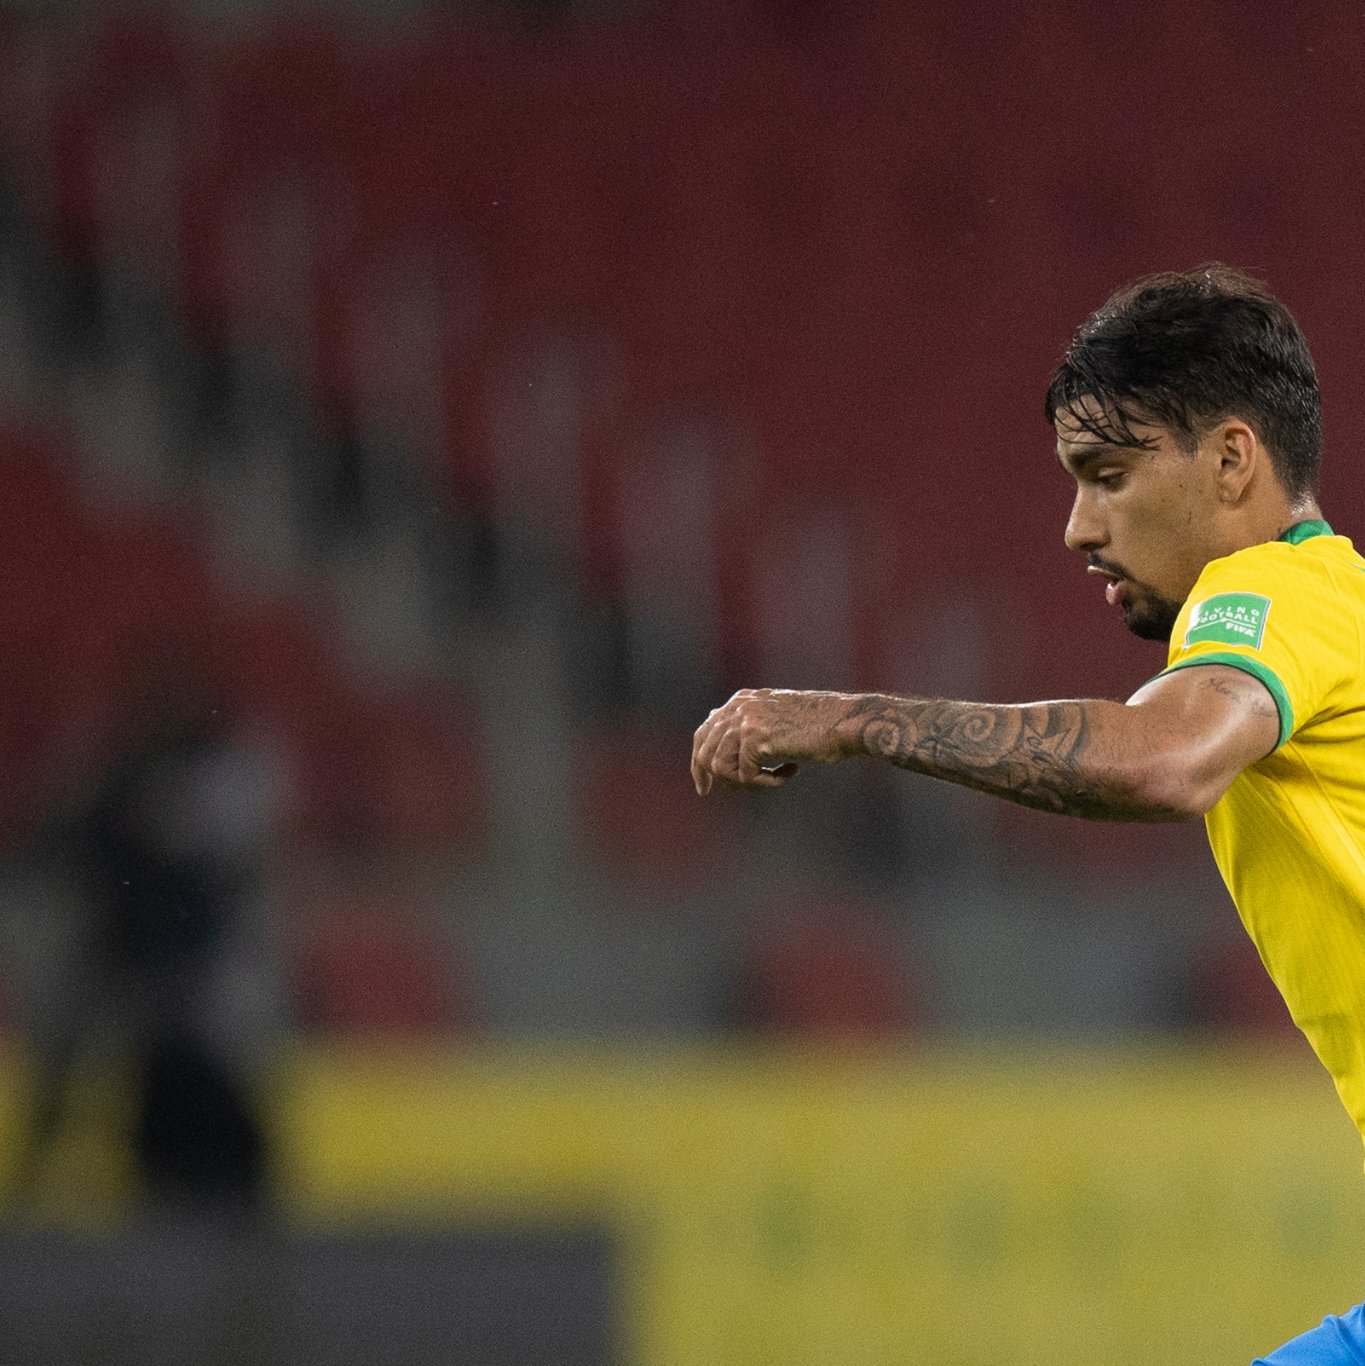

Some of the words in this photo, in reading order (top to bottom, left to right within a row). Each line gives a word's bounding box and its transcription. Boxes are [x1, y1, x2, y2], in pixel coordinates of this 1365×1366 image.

[1198, 606, 1260, 617] IVING
[1198, 611, 1258, 625] OOTBALL
[1225, 622, 1257, 637] FIFA
